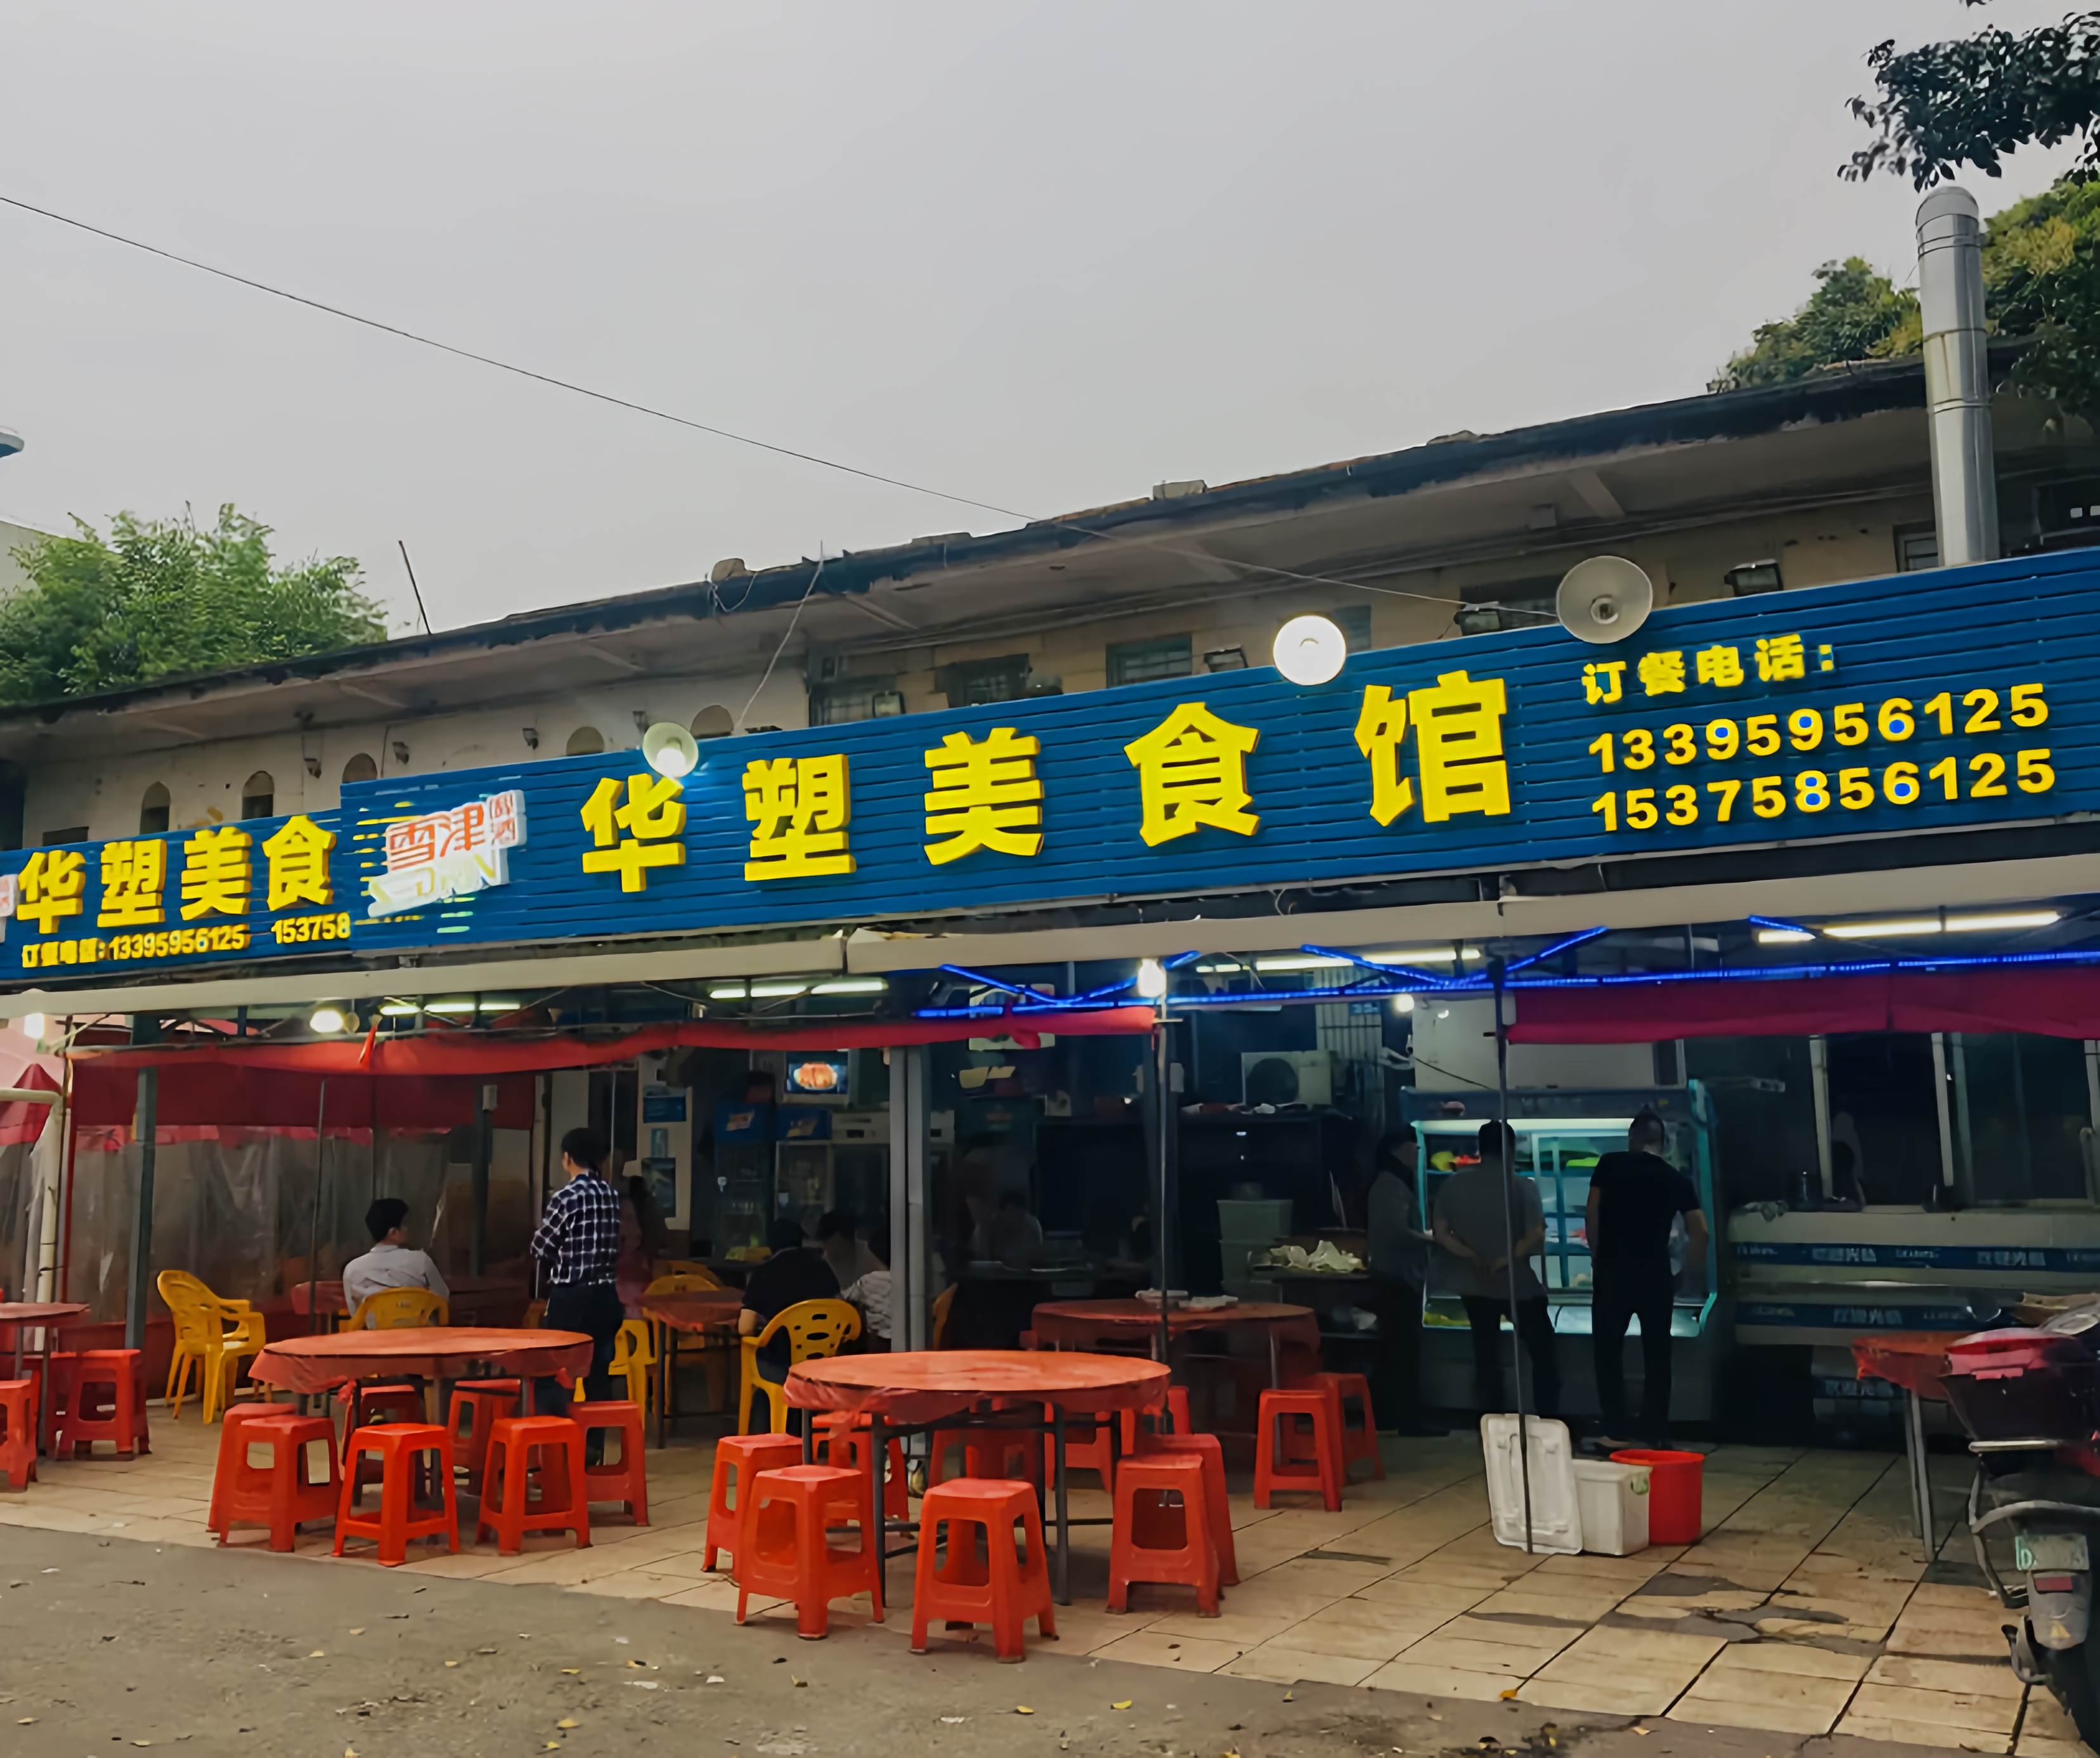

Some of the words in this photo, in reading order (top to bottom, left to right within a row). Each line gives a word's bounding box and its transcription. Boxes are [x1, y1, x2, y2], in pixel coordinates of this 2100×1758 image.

[1581, 633, 1834, 705] 订餐电话:
[1588, 682, 2049, 773] 13395956125
[580, 670, 1512, 894] 华塑美食馆
[1591, 748, 2056, 832] 15375856125
[16, 814, 337, 934] 华塑美食
[271, 912, 351, 944] 153758
